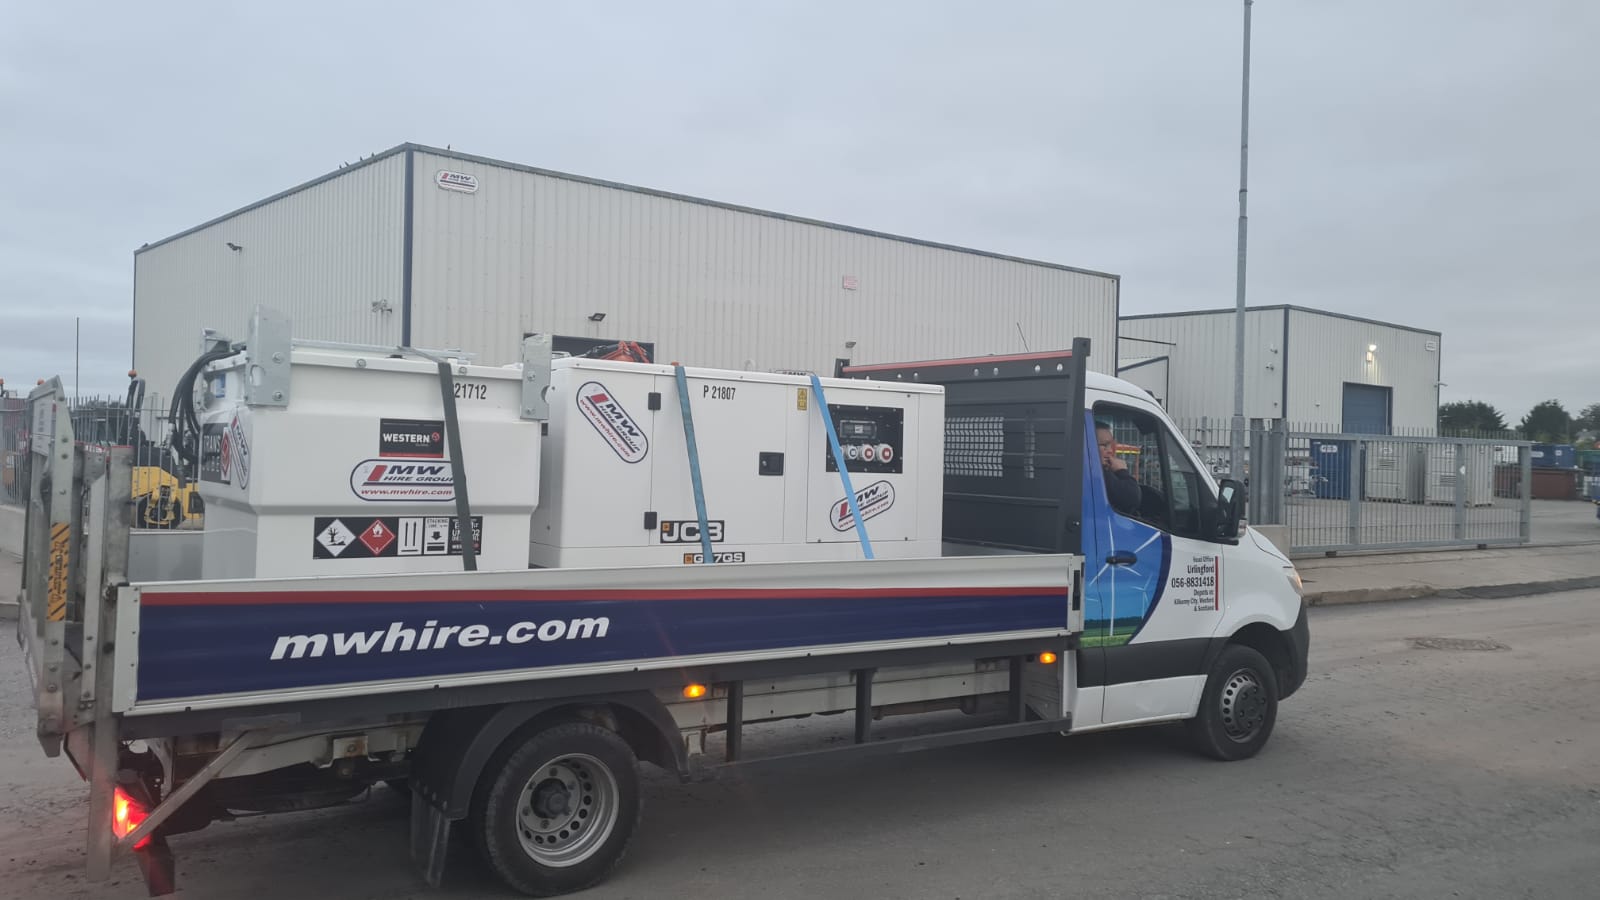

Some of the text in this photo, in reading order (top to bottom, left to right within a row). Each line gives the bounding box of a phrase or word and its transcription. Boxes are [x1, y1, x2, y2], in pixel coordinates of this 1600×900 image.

[454, 383, 487, 400] 21712
[703, 385, 736, 400] P 21807
[606, 403, 640, 436] MW
[383, 433, 431, 443] WESTERN
[388, 465, 445, 475] MW
[361, 488, 453, 496] www.mwhire.com
[662, 522, 722, 542] JCB
[693, 552, 743, 563] G7QS
[1187, 564, 1214, 575] Urlingford
[1172, 577, 1214, 588] 056-8831418
[270, 616, 610, 660] mwhire.com
